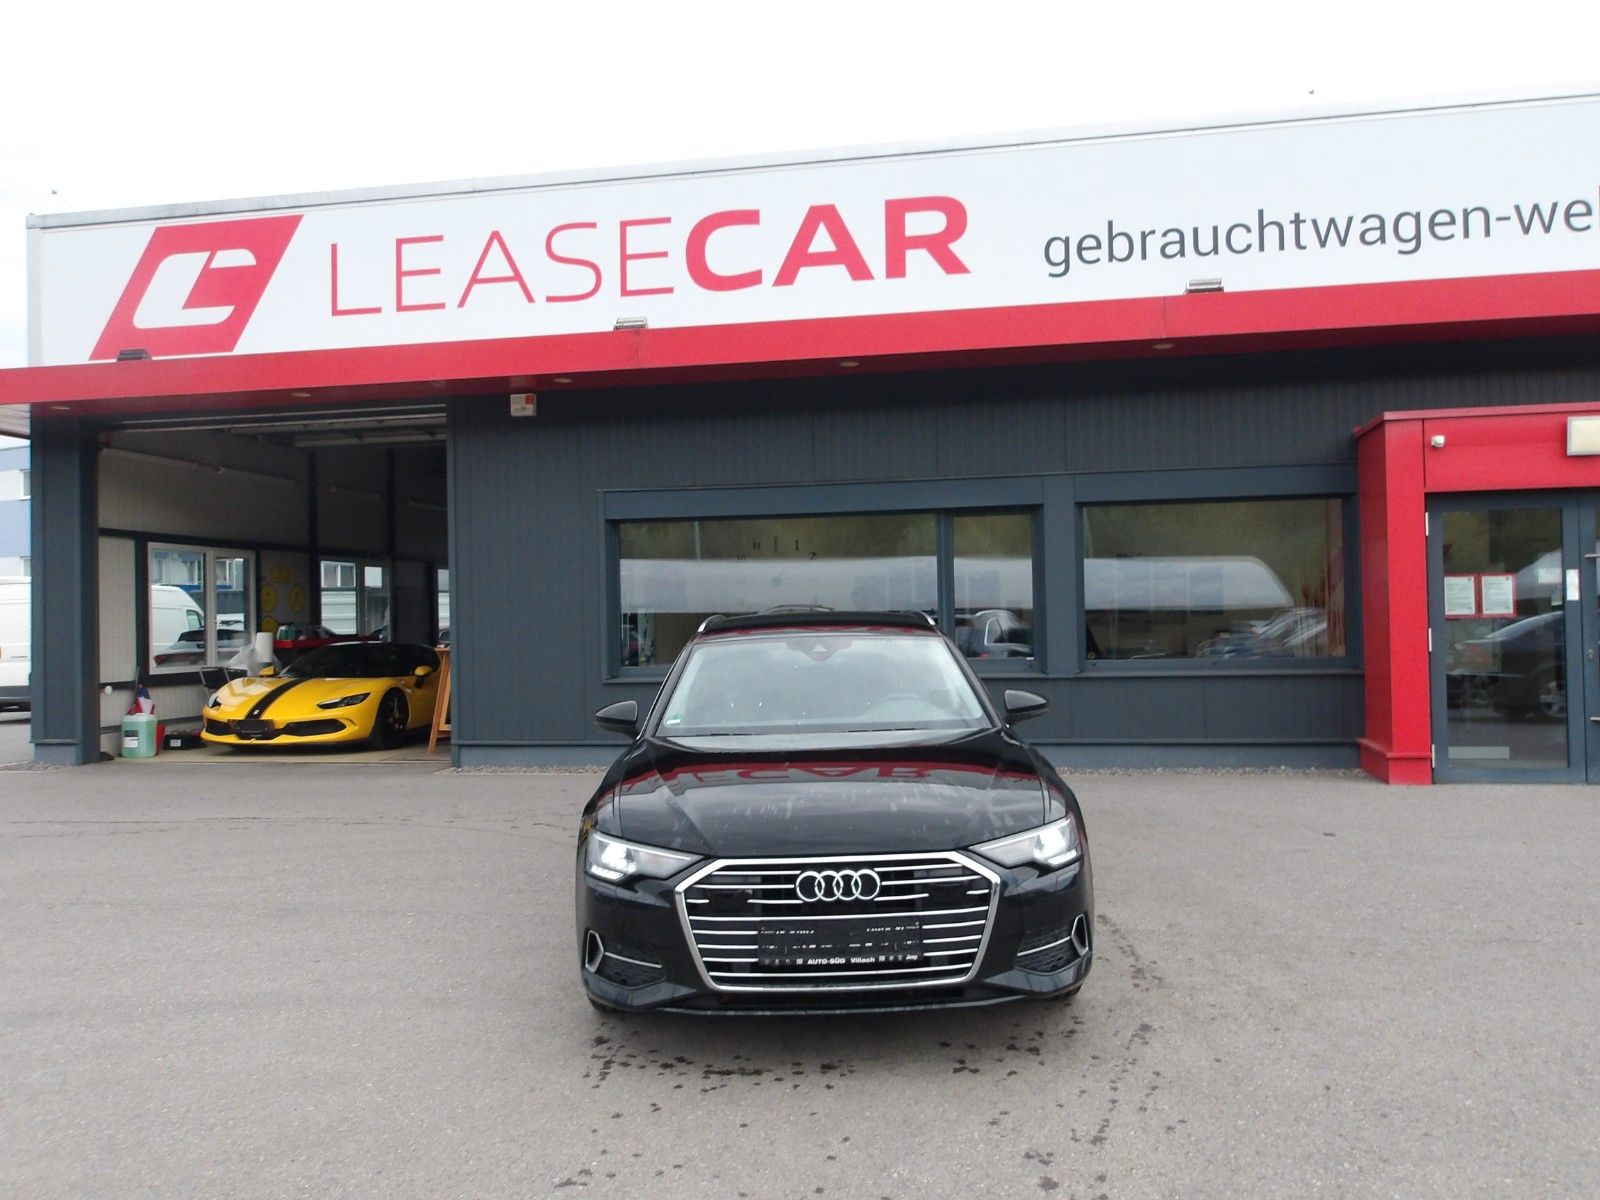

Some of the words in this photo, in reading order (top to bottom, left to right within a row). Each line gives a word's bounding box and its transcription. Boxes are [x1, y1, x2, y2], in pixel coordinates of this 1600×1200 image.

[331, 195, 970, 317] LEASECAR
[1044, 184, 1600, 278] gebrauchtwagen-we
[807, 957, 846, 965] AUTO-SÜD
[851, 956, 876, 964] Villach
